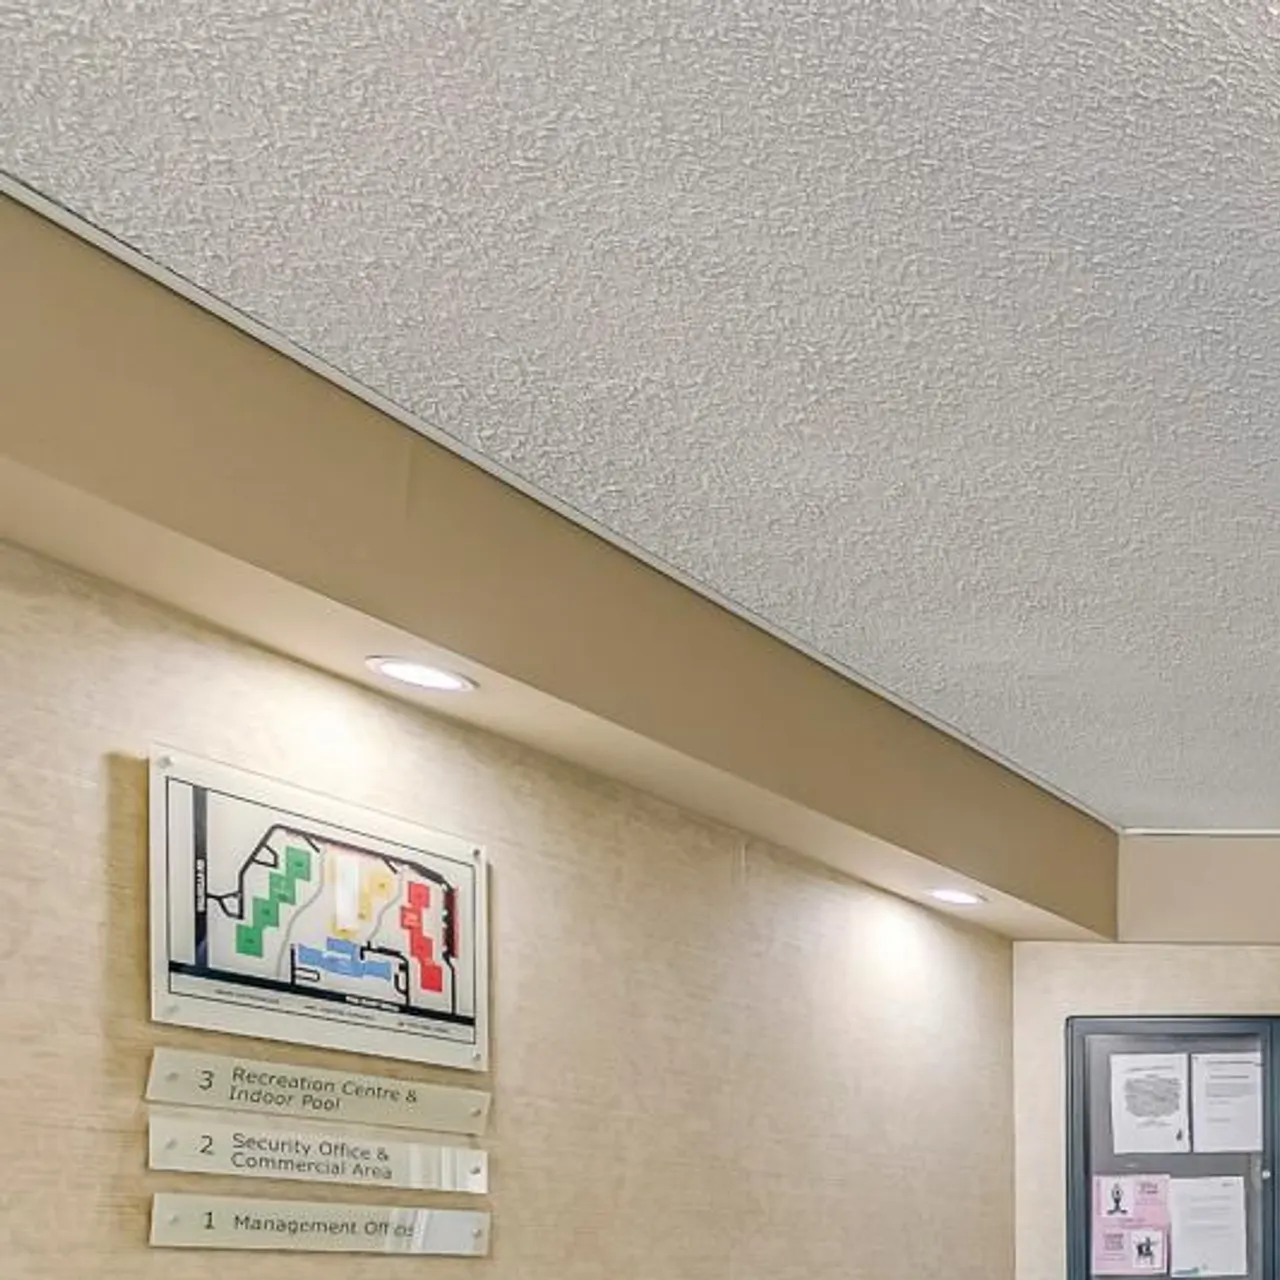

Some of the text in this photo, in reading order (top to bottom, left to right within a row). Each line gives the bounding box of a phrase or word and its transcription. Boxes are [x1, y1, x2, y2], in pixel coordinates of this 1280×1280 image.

[198, 1065, 418, 1103] 3 Recreation Centre &
[228, 1085, 341, 1111] Indoor Pool
[199, 1132, 390, 1162] 2 Security Office &
[230, 1152, 393, 1180] Commercial Area
[203, 1211, 216, 1230] 1
[234, 1214, 357, 1235] Management
